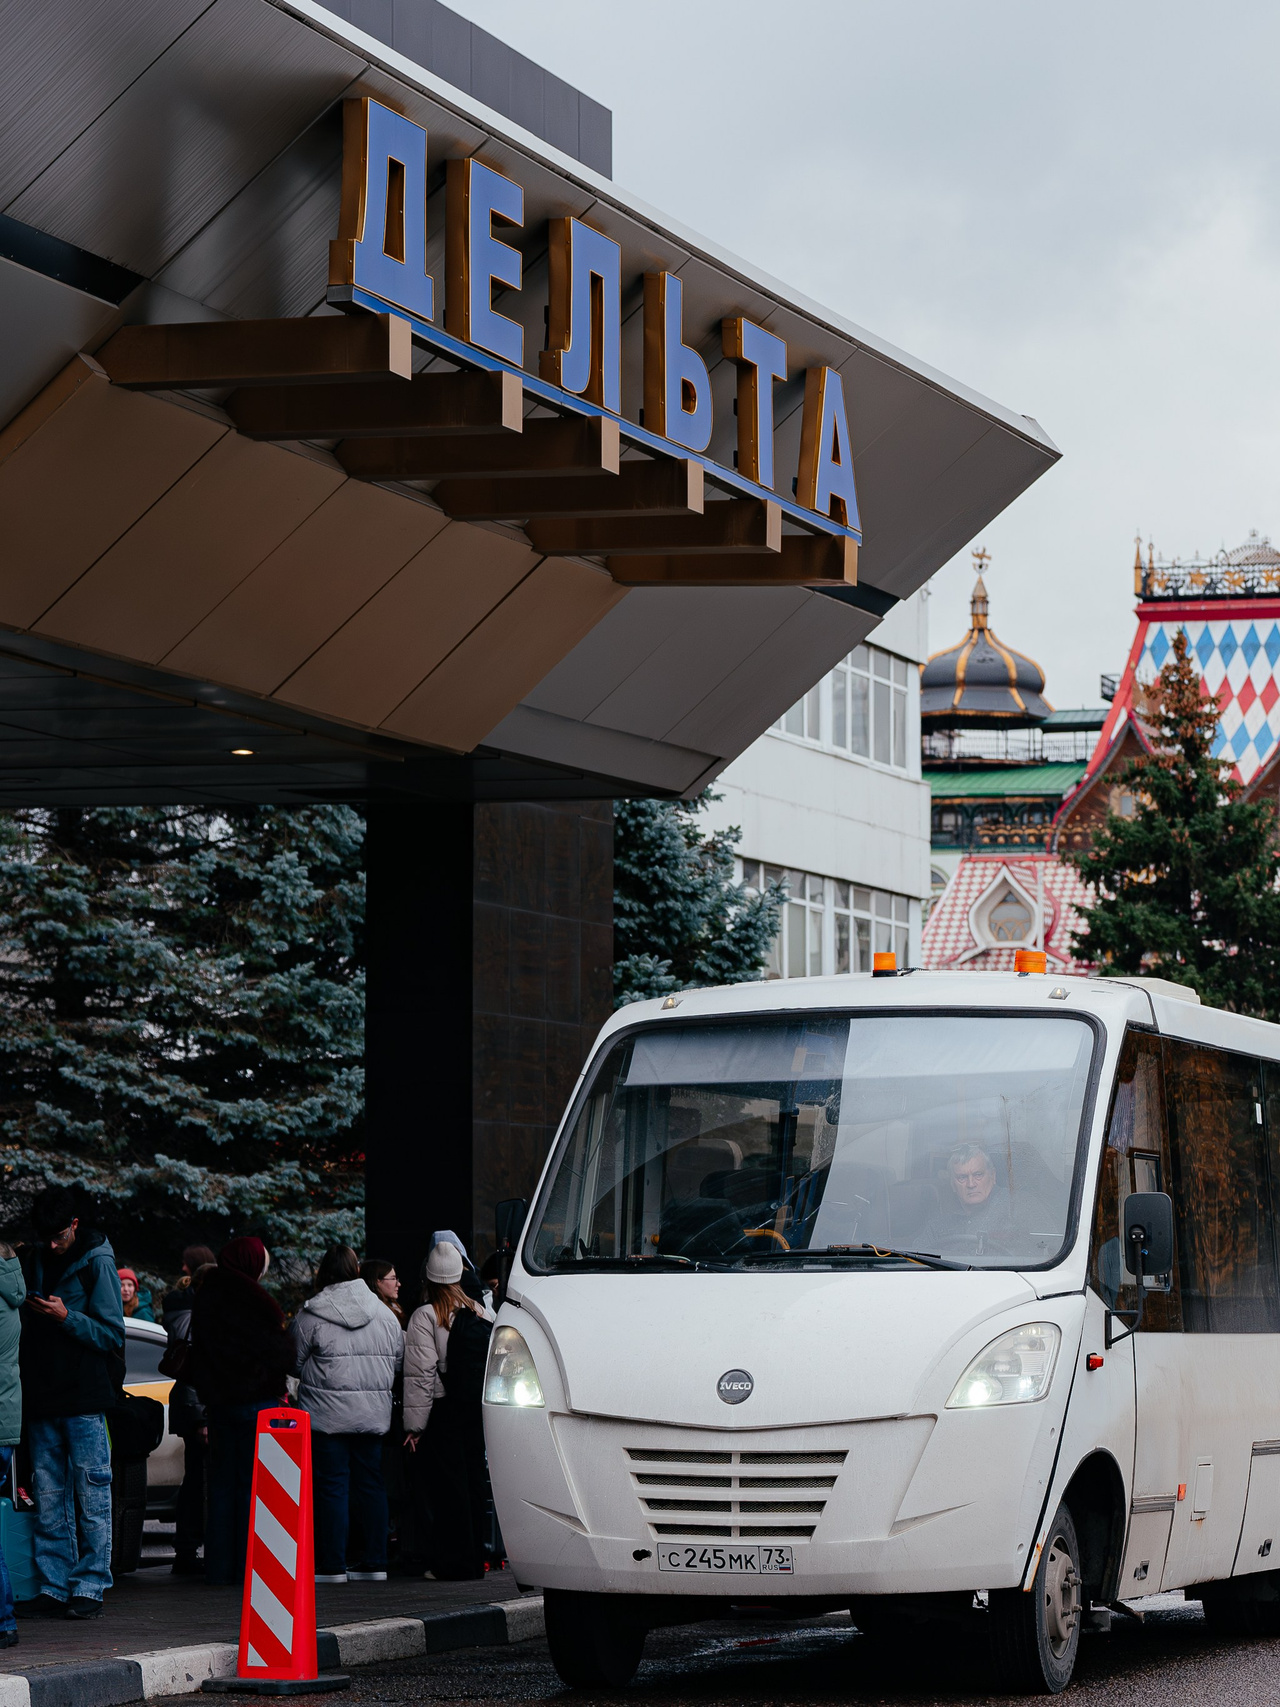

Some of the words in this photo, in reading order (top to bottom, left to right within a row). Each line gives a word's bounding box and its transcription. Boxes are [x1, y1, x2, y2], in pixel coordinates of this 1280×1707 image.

[331, 96, 862, 534] ДЕЛЬТА
[720, 1382, 752, 1390] IVECO
[762, 1548, 785, 1564] 73
